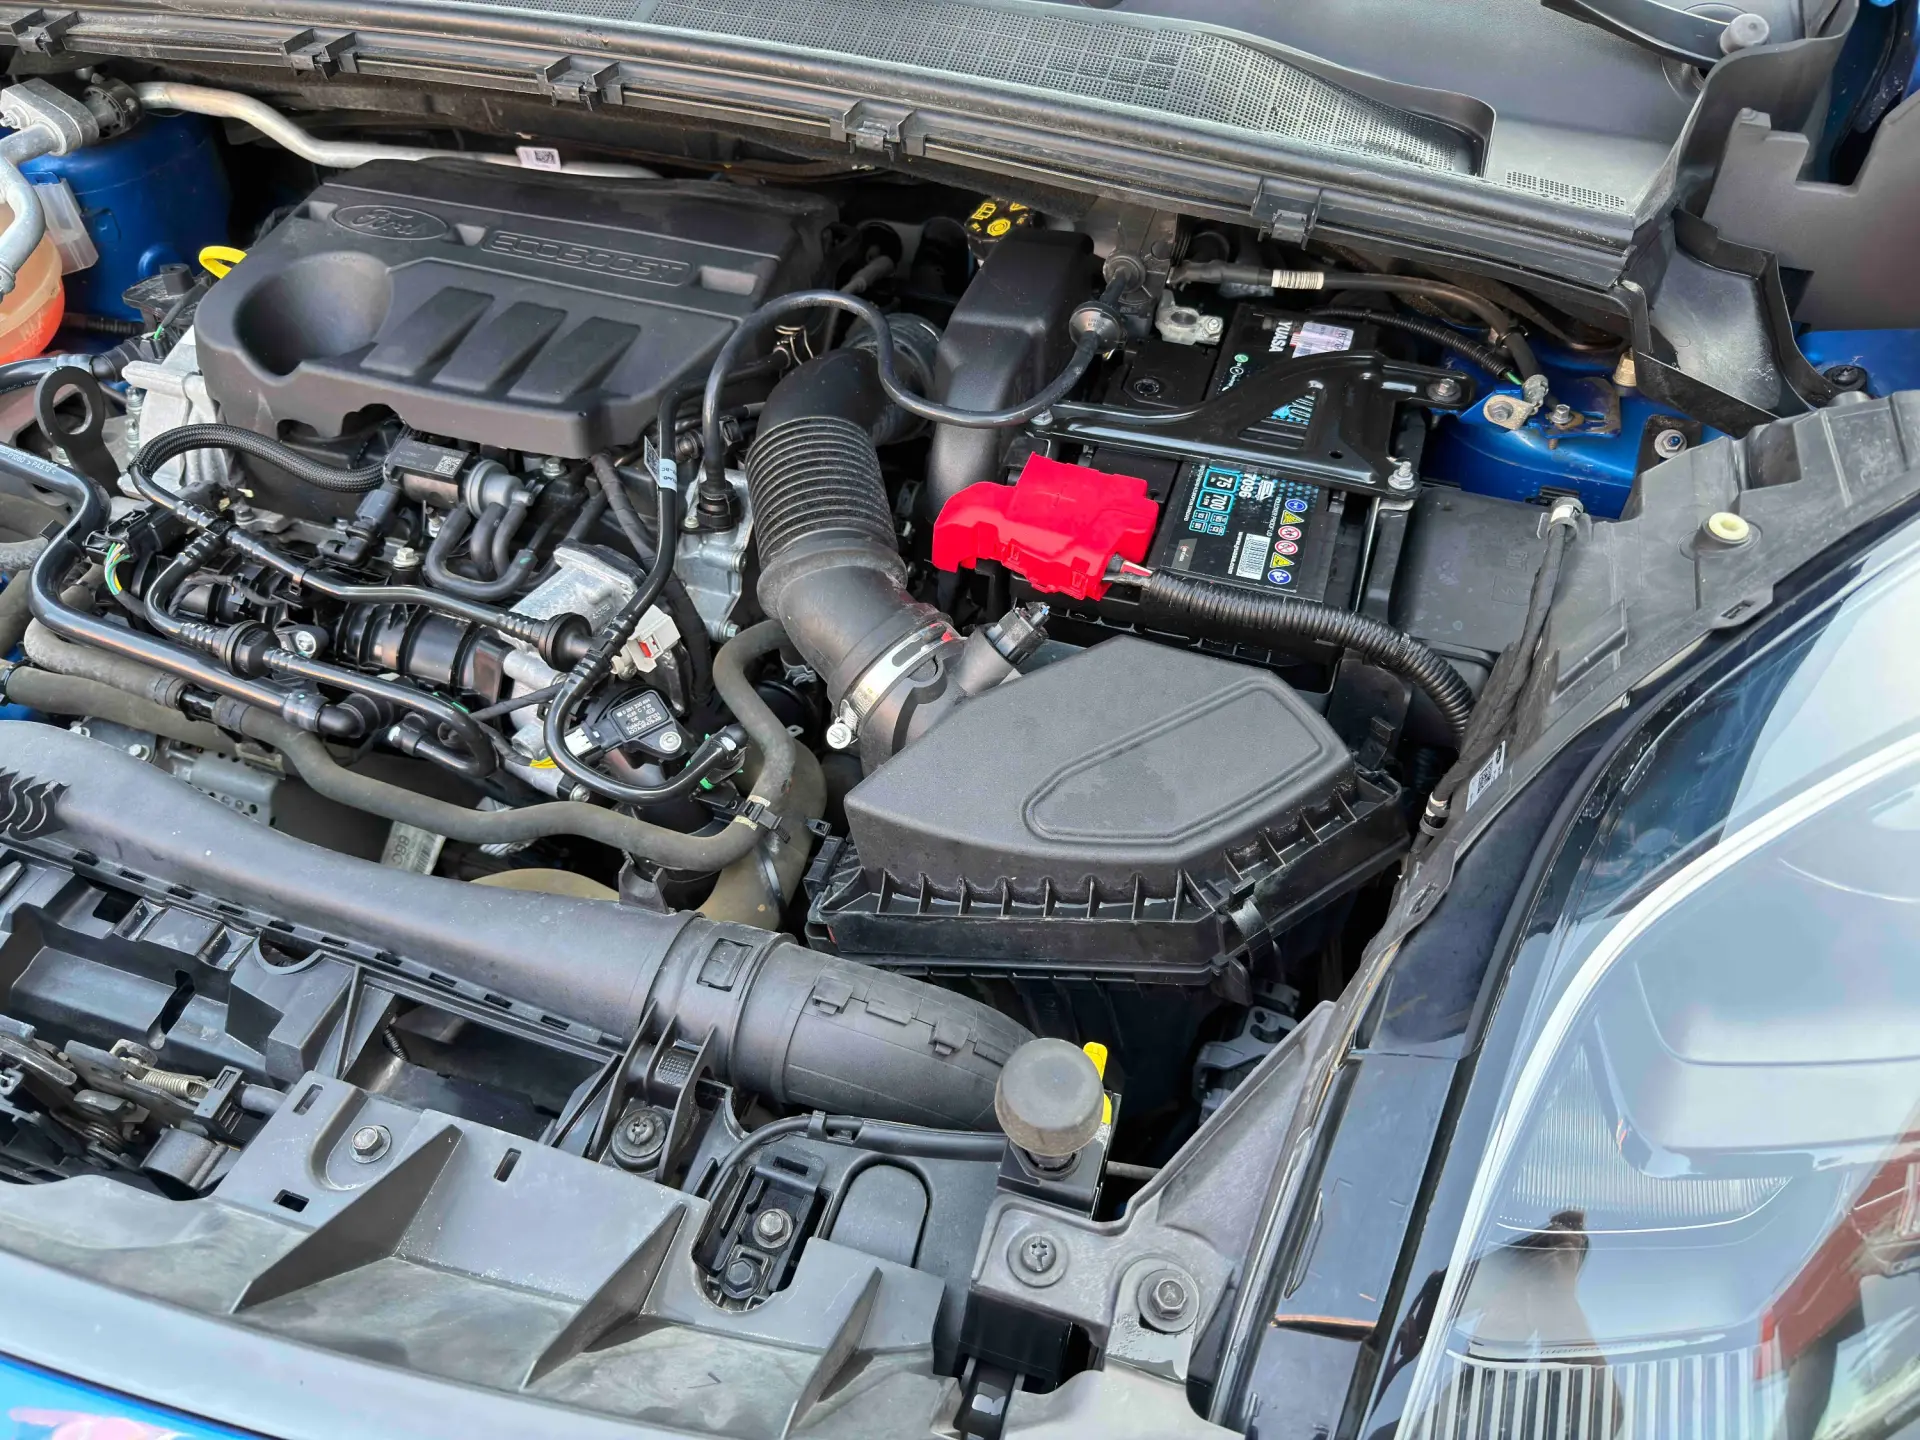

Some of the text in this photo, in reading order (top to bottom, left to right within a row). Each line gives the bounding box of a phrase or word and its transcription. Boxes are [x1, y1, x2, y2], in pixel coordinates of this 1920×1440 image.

[351, 208, 428, 236] Ford
[491, 234, 683, 278] ECOBOOST
[1268, 321, 1293, 352] YUASA
[1217, 476, 1234, 489] 75
[1239, 474, 1257, 498] 7096
[1210, 494, 1228, 511] 700
